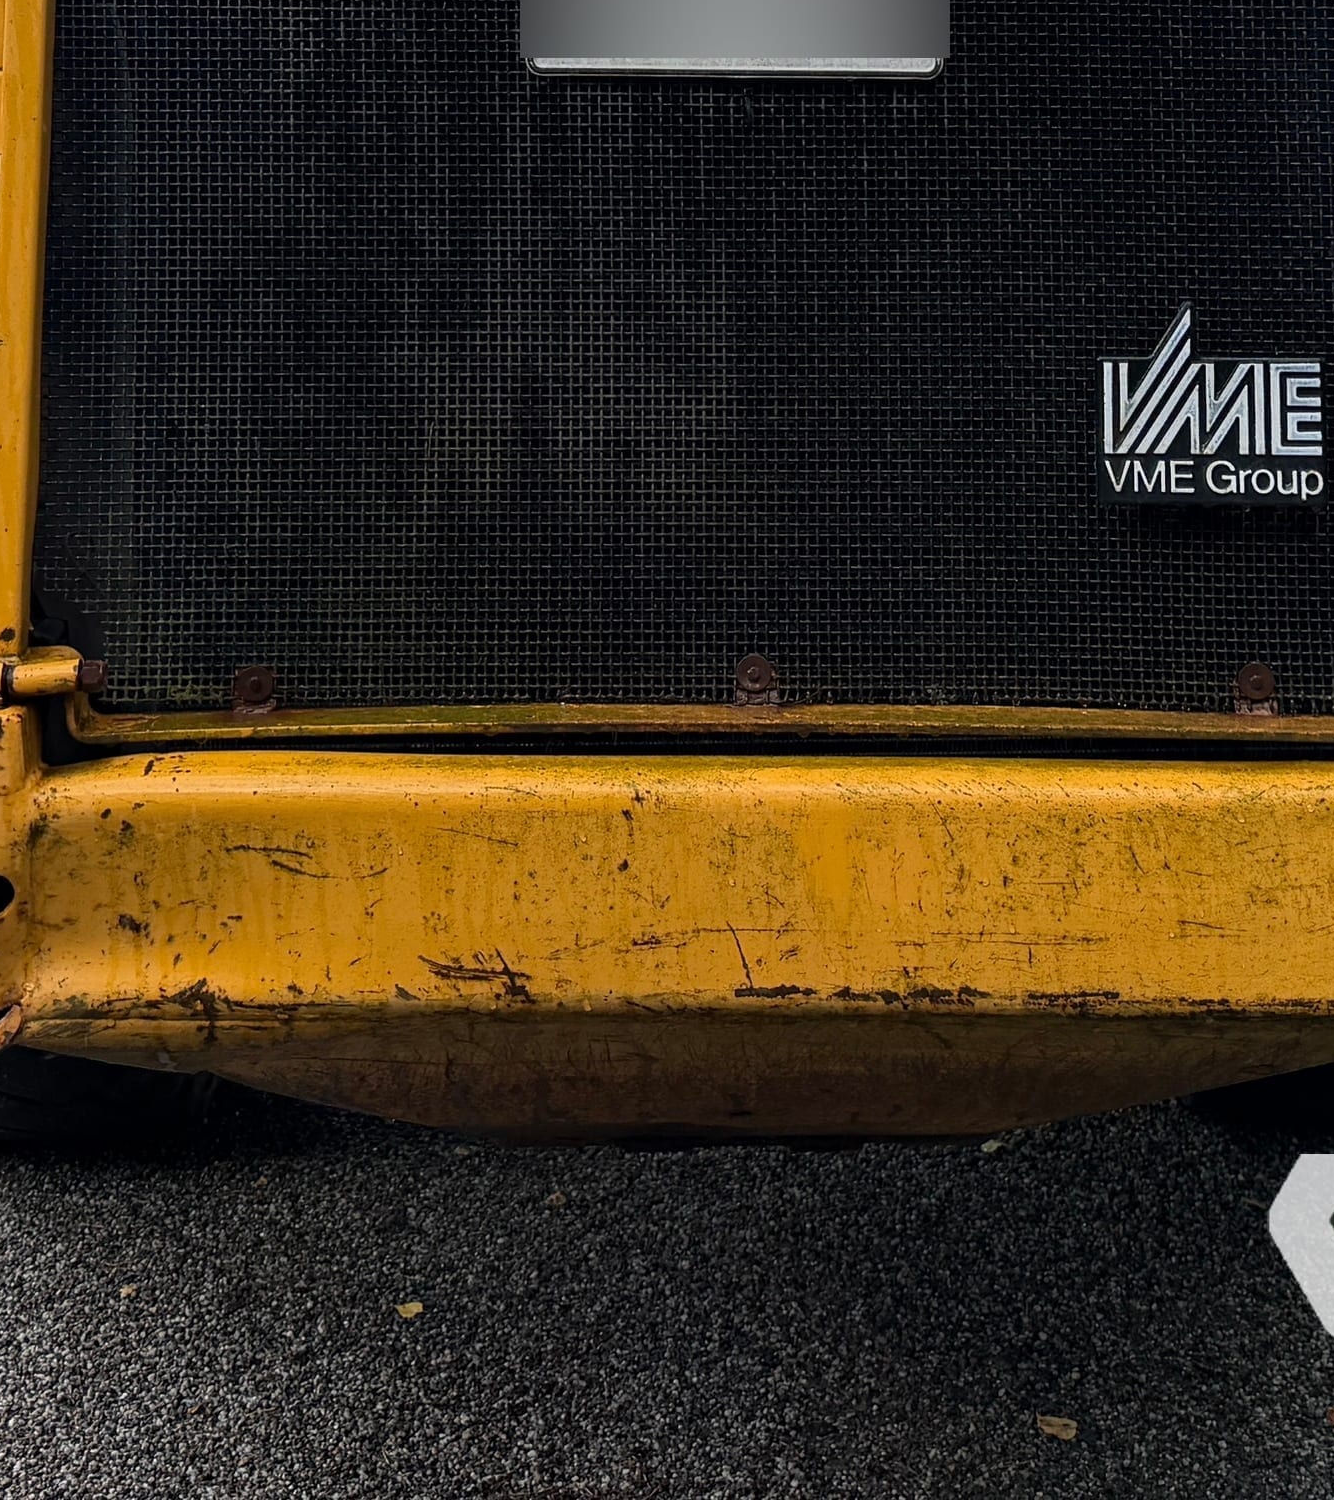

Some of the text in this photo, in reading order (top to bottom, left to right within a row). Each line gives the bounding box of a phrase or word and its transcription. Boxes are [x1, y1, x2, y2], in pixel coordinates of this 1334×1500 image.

[1103, 308, 1323, 456] VME
[1104, 459, 1324, 500] VME Group
